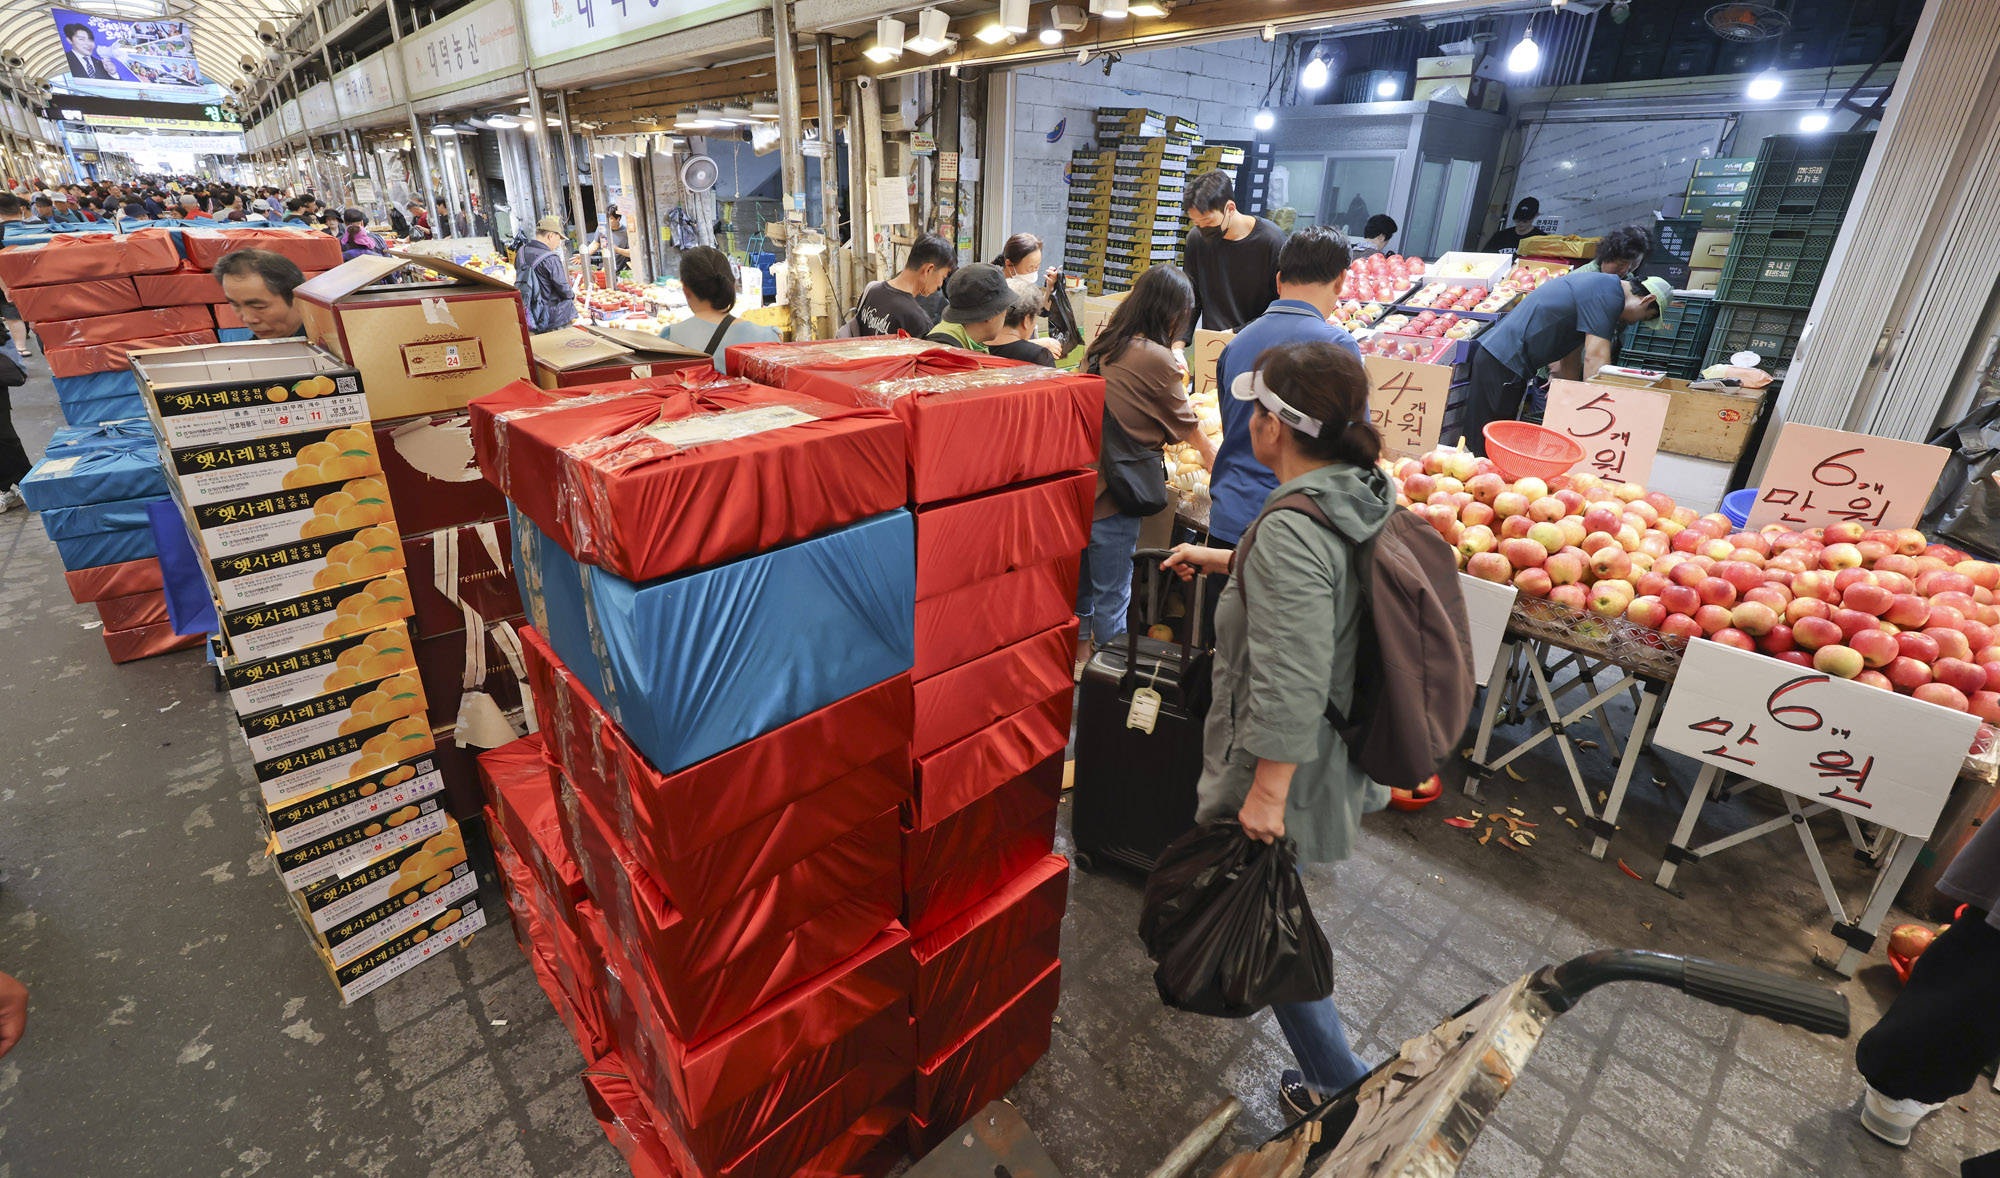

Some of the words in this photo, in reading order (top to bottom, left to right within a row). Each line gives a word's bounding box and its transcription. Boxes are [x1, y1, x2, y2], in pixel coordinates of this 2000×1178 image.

[427, 23, 479, 77] 대덕농산
[1768, 261, 1791, 270] 국내산
[447, 357, 459, 366] 24
[176, 391, 229, 410] 햇사레
[230, 388, 261, 396] 장호원
[279, 415, 289, 425] 상
[310, 411, 321, 420] 11
[196, 446, 255, 469] 햇사레
[256, 441, 290, 452] 장호원
[275, 492, 308, 503] 장호원
[218, 499, 274, 522] 햇사레
[289, 543, 320, 554] 장호원
[234, 550, 288, 574] 햇사레
[459, 568, 501, 584] remium
[300, 595, 331, 607] 장호원
[246, 604, 298, 629] 햇사레
[246, 657, 299, 682] 햇사레
[263, 704, 314, 730] 햇사레
[276, 748, 326, 774] 햇사레
[394, 794, 404, 802] 13
[287, 799, 330, 823] 햇사레
[399, 834, 408, 842] 13
[294, 840, 335, 863] 햇사레
[323, 873, 368, 903] 햇사레
[340, 912, 378, 938] 햇사레
[351, 950, 388, 976] 햇사레
